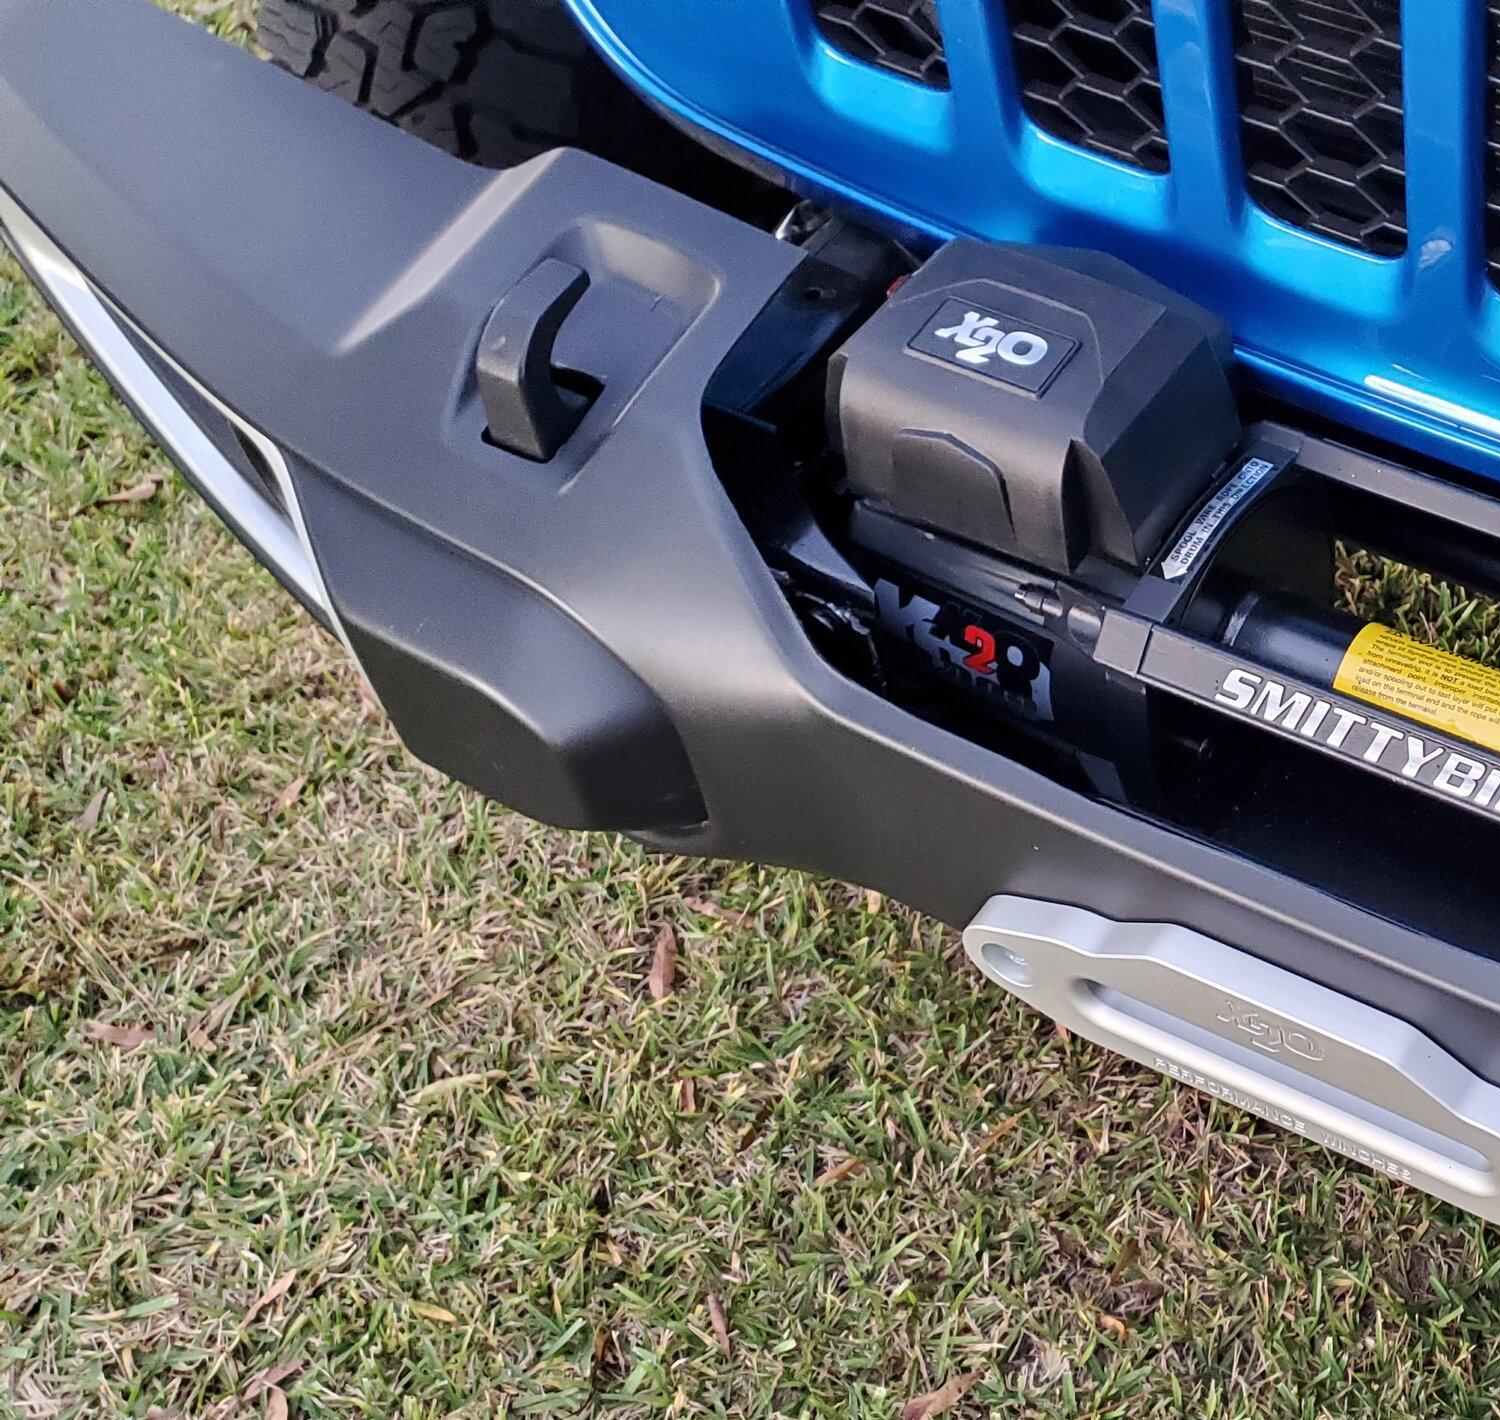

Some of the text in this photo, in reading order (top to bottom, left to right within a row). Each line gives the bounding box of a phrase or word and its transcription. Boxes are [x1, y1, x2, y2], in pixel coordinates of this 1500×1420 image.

[1171, 531, 1197, 561] SPOOL
[1195, 504, 1216, 525] WIRE
[1216, 482, 1238, 503] ROPE
[1180, 464, 1270, 565] DRUM IN THIS DIRECTION
[1361, 658, 1403, 675] attachment
[1433, 679, 1468, 696] Improper
[1367, 650, 1384, 660] from
[1440, 673, 1459, 685] NOT
[1467, 682, 1484, 692] load
[1372, 643, 1385, 653] The
[1388, 650, 1417, 662] terminal
[1419, 659, 1432, 667] end
[1454, 671, 1482, 684] prevent
[1484, 680, 1497, 689] the
[1351, 684, 1377, 698] release
[1378, 691, 1395, 702] from
[1395, 696, 1408, 706] the
[1355, 674, 1371, 684] load
[1371, 680, 1382, 688] on
[1383, 682, 1396, 692] the
[1396, 687, 1426, 702] terminal
[1426, 696, 1441, 706] end
[1440, 701, 1456, 711] and
[1456, 705, 1469, 715] the
[1469, 710, 1488, 721] rope
[1358, 666, 1382, 678] and/or
[1383, 674, 1414, 689] spooling
[1414, 683, 1428, 692] out
[1429, 687, 1437, 695] to
[1437, 689, 1451, 700] last
[1452, 694, 1471, 706] layer
[1471, 701, 1485, 710] will
[1485, 705, 1499, 715] put
[1153, 1056, 1307, 1134] PERFORMANCE
